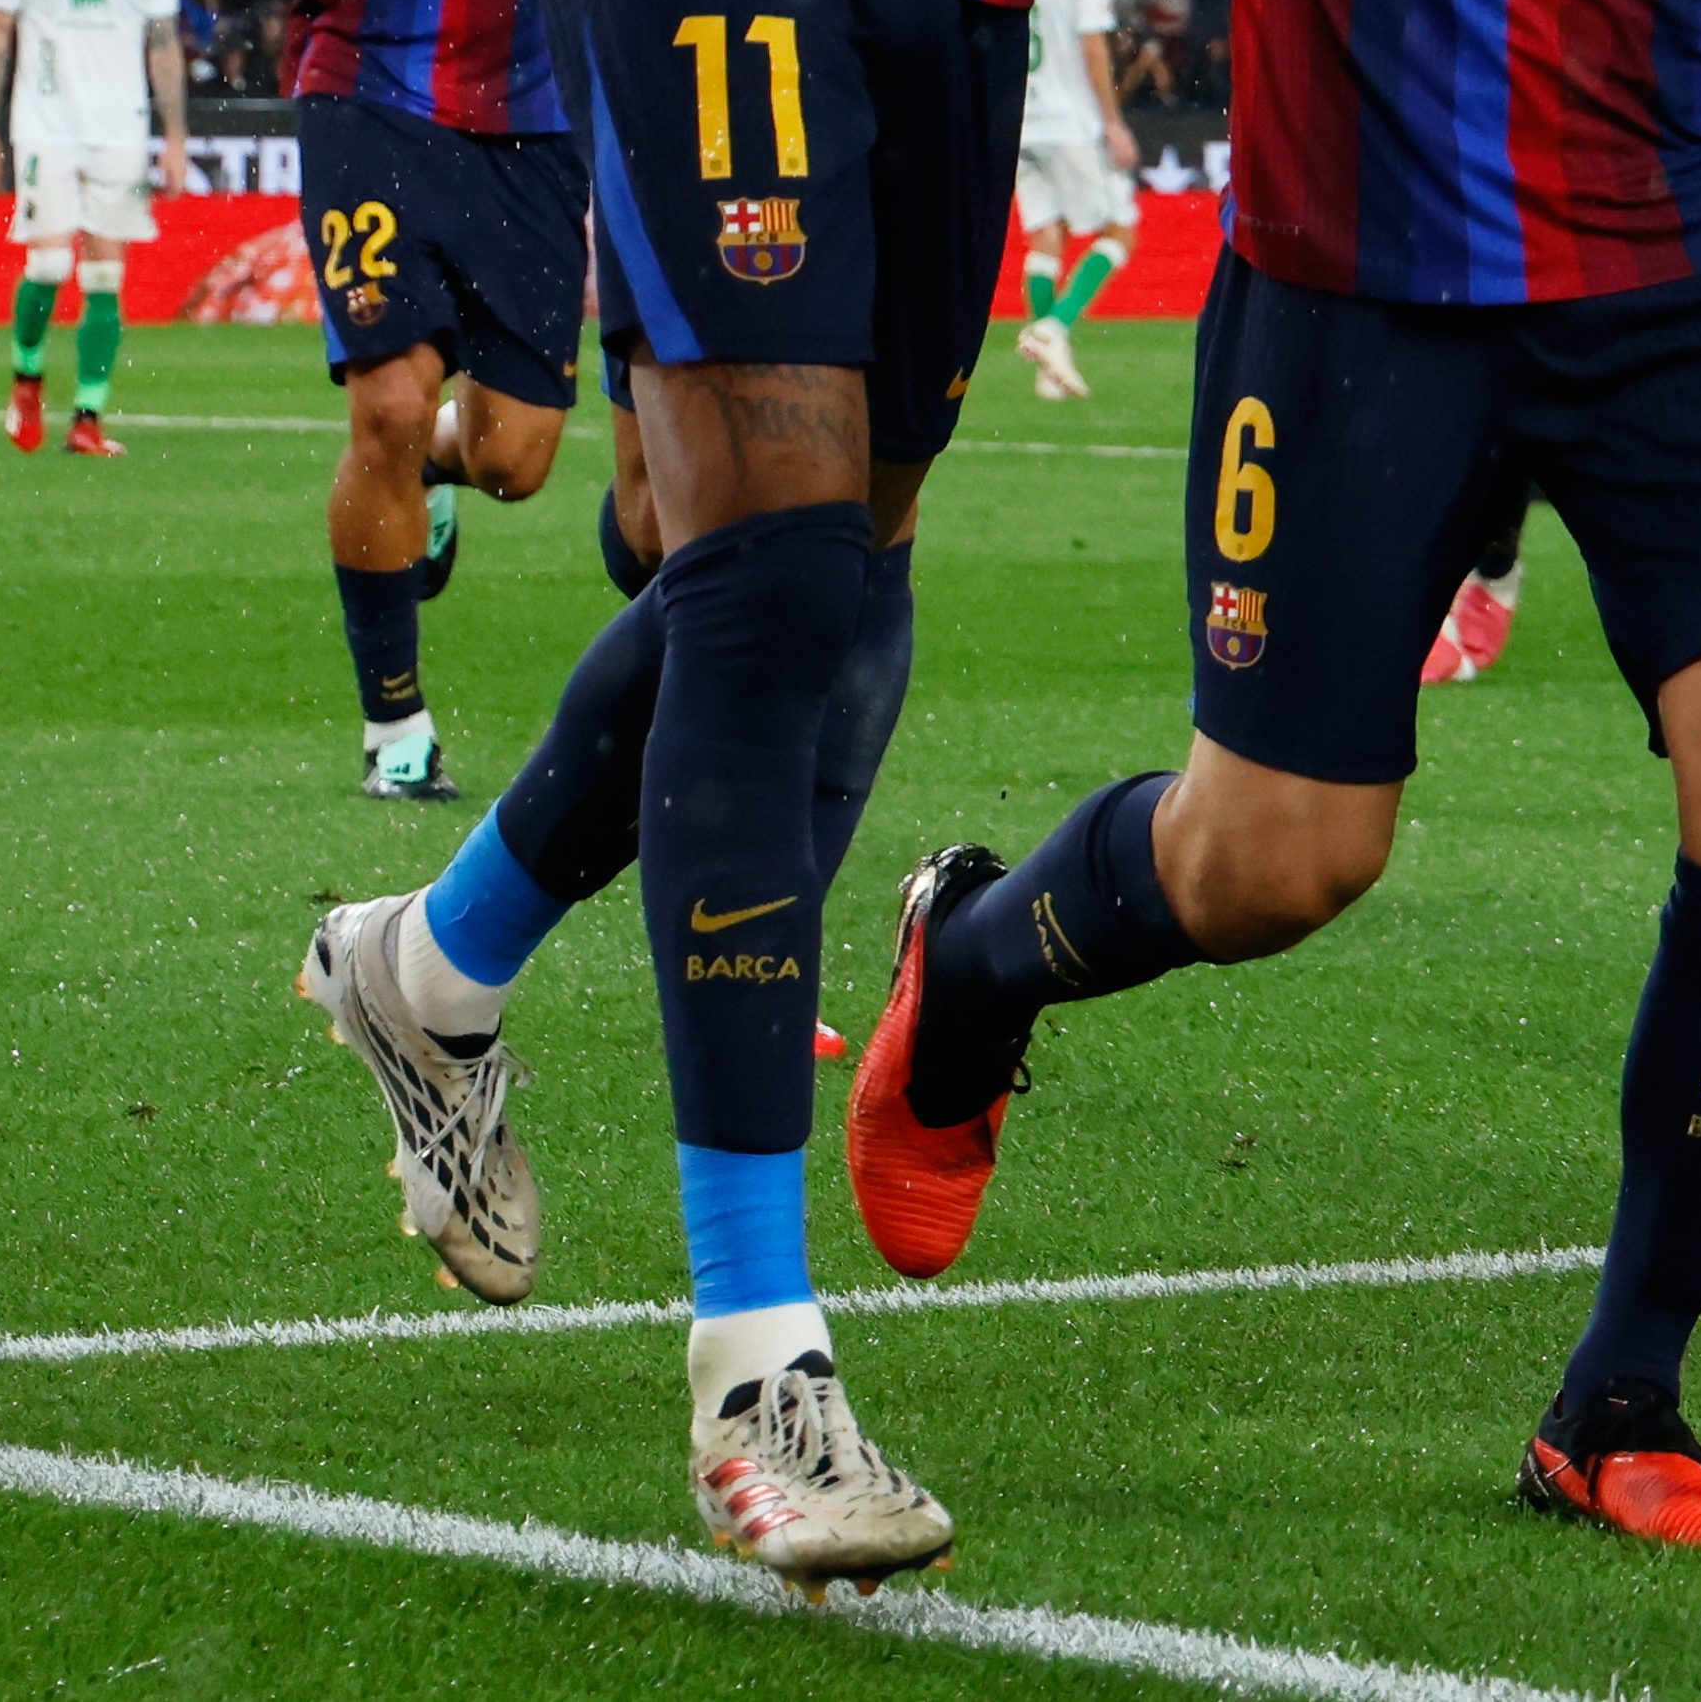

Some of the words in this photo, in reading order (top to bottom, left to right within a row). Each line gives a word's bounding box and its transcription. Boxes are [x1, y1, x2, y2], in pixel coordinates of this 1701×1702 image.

[671, 14, 810, 181] 11
[320, 200, 399, 290] 22
[1214, 395, 1277, 562] 6
[685, 953, 801, 984] BARÇA
